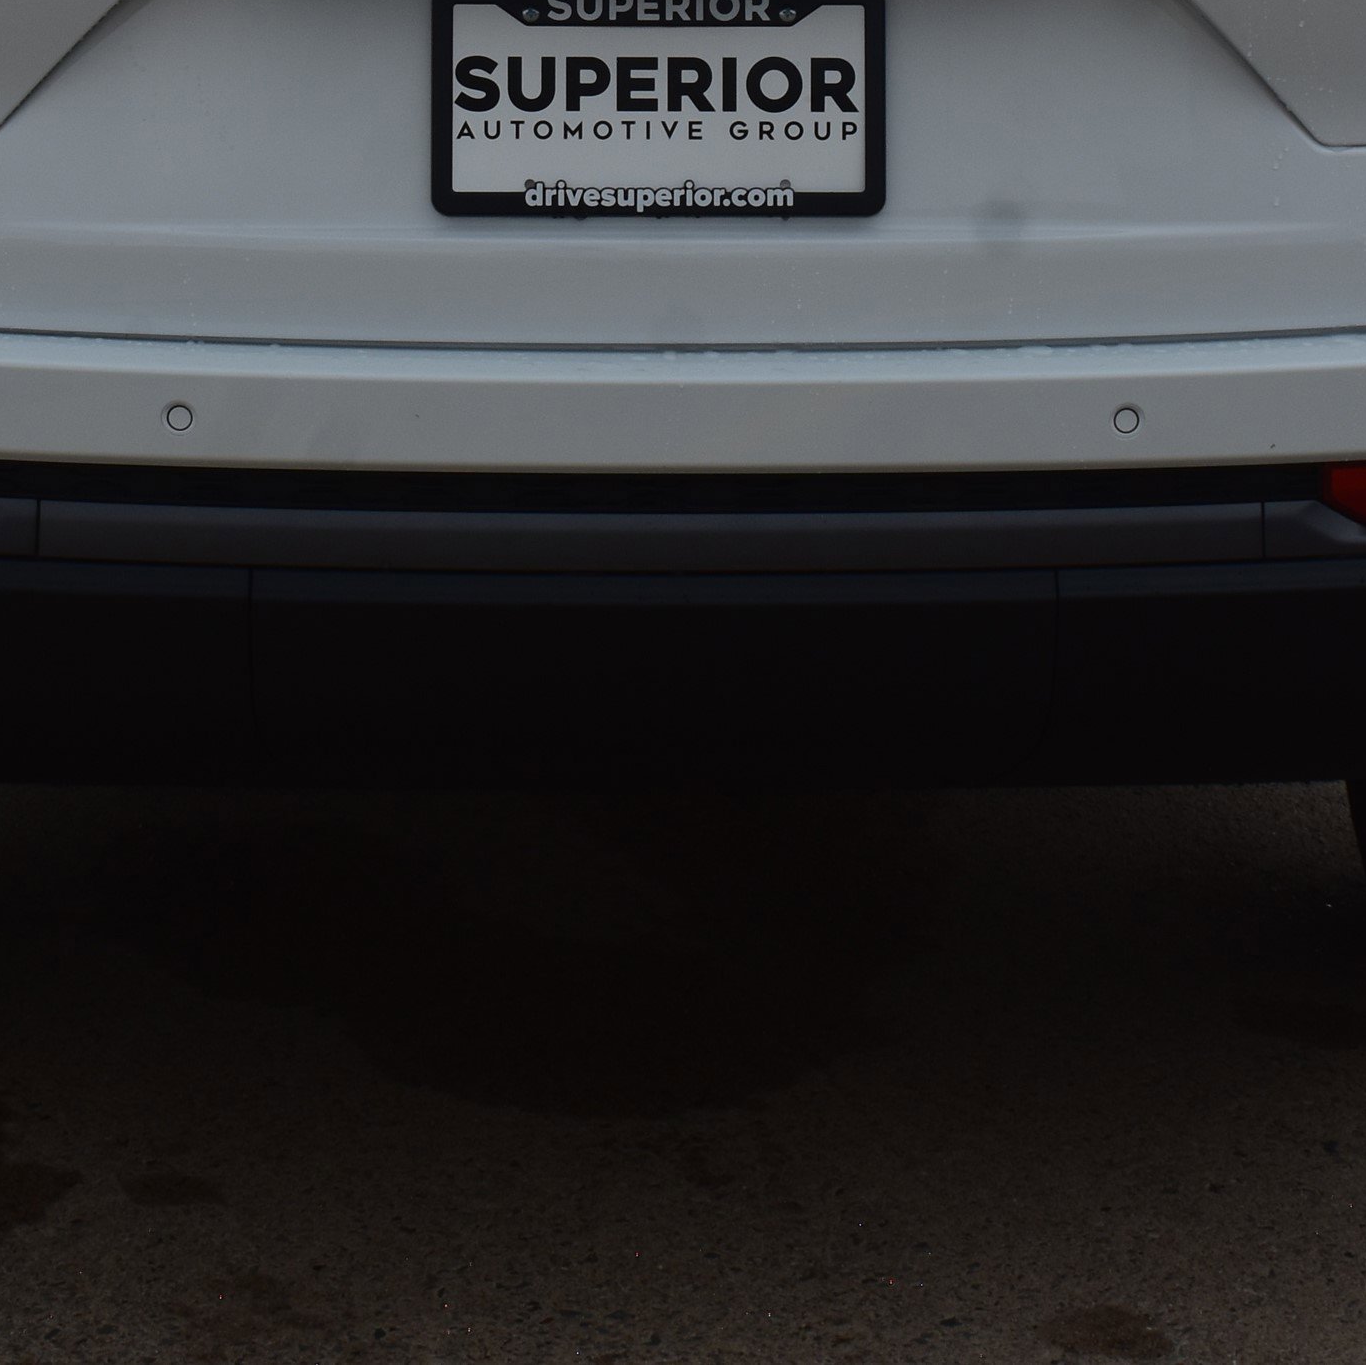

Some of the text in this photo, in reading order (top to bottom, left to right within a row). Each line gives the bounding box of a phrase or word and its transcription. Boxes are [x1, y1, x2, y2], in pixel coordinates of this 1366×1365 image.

[454, 55, 859, 113] SUPERIOR
[456, 120, 859, 141] AUTOMOTIVE GROUP
[524, 180, 795, 213] drivesuperior.com
